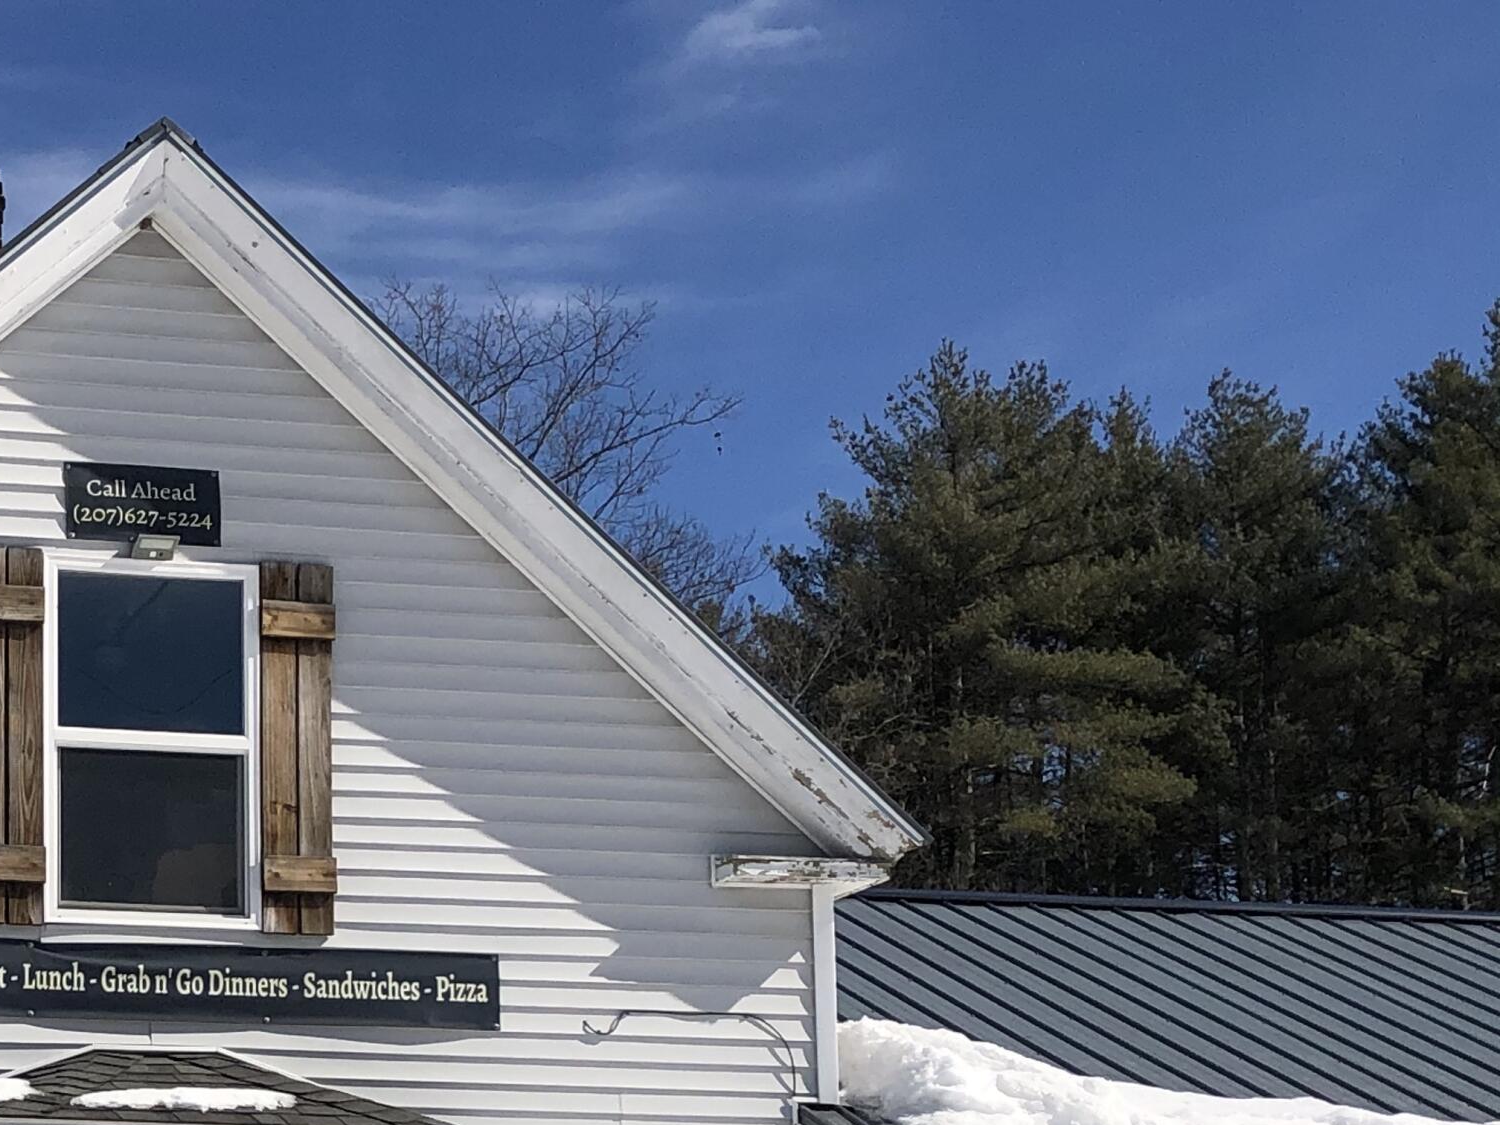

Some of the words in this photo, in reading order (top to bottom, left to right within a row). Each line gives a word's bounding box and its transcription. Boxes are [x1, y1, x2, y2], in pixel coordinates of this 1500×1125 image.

[86, 479, 127, 498] Call
[131, 481, 196, 502] Ahead
[73, 507, 213, 530] (207)627-5224
[23, 961, 85, 991] Lunch
[101, 964, 150, 994] Grab
[155, 969, 173, 995] n'
[176, 968, 204, 995] Go
[208, 967, 289, 998] Dinners
[303, 970, 420, 1002] Sandwiches
[435, 974, 489, 1003] Pizza
